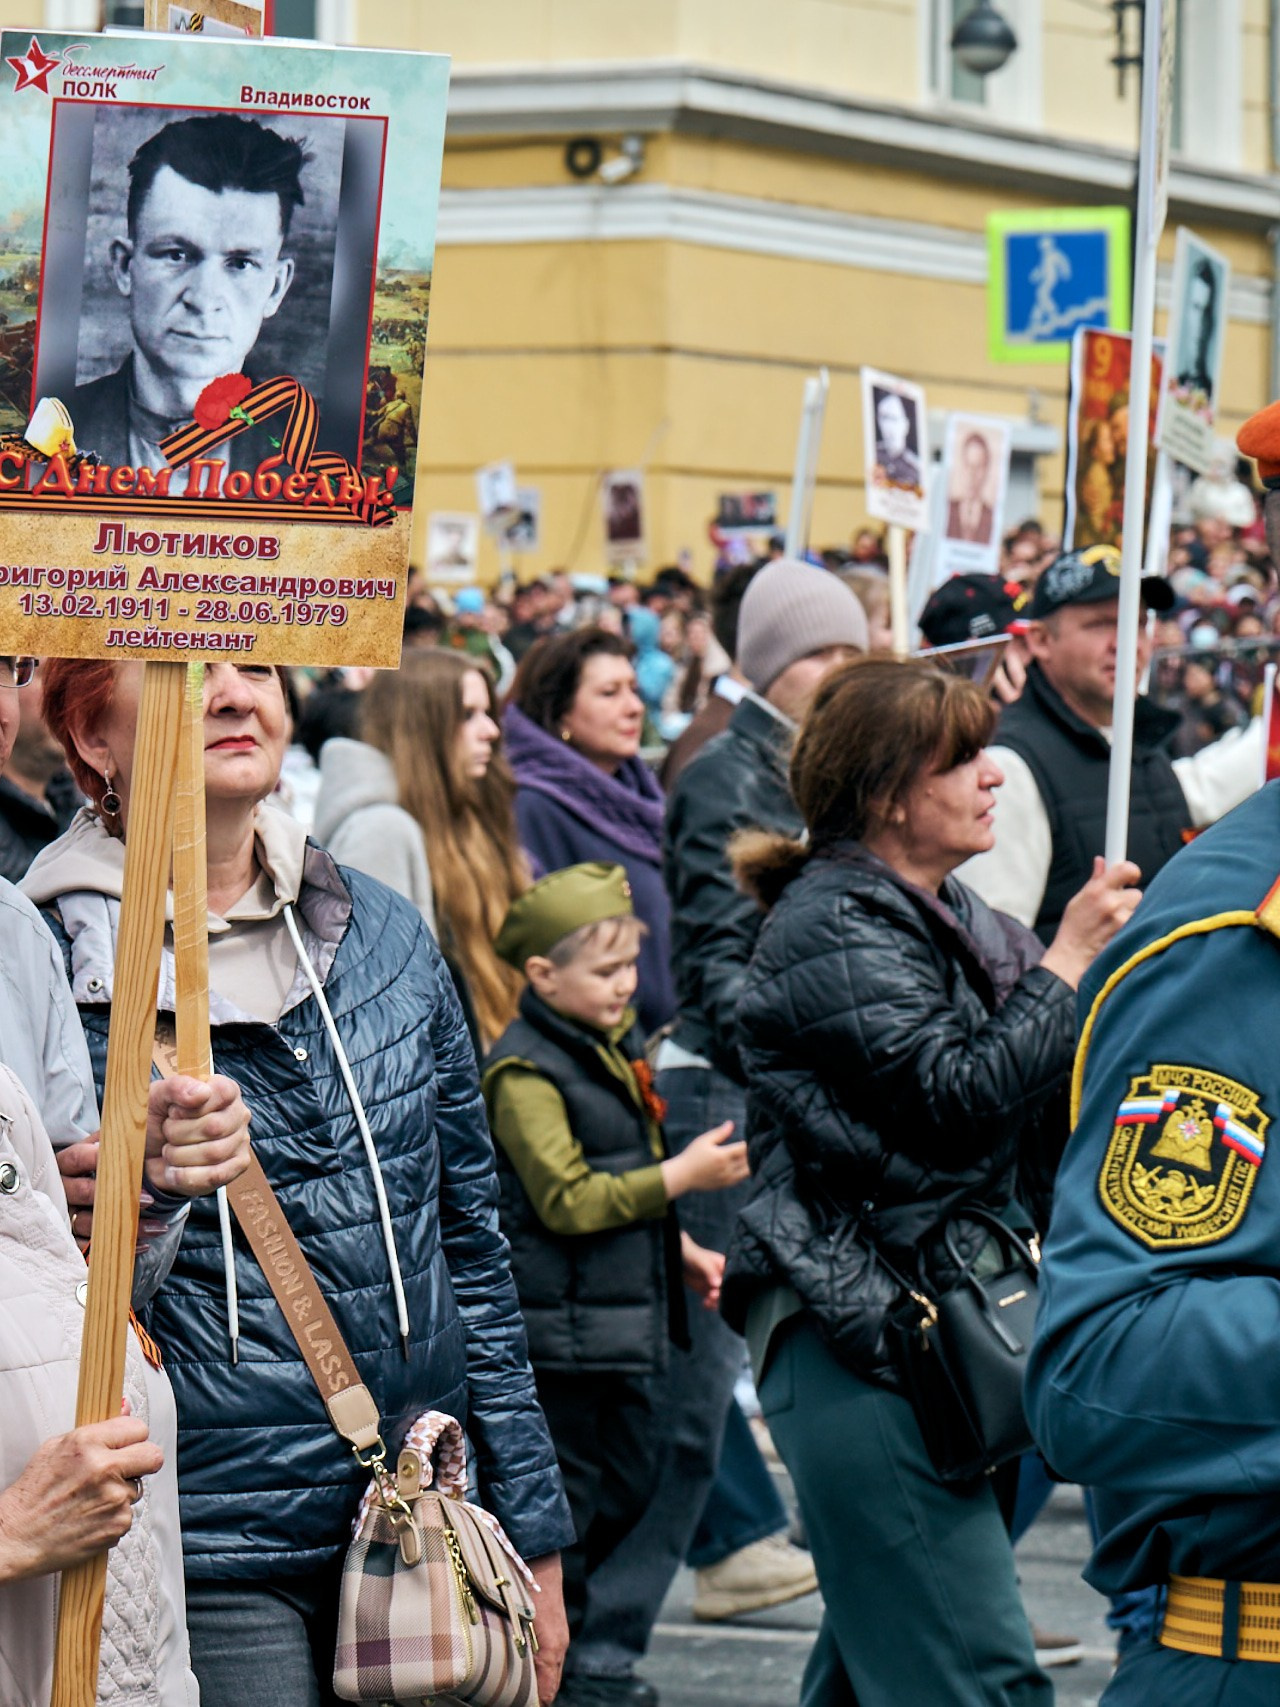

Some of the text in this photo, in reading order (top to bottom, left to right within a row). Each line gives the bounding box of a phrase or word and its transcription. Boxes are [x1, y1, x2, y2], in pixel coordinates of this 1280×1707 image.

[62, 80, 117, 98] ПОЛК
[240, 85, 371, 109] Владивосток
[1093, 336, 1113, 377] 9
[31, 453, 173, 499] Днем
[184, 453, 399, 508] Победы!
[93, 522, 281, 560] Лютиков
[137, 565, 397, 600] Александрович
[18, 593, 170, 620] 13.02.1911
[195, 599, 347, 625] 28.06.1979
[105, 626, 256, 652] лейтенант
[1157, 1070, 1251, 1109] МЧС РОССИИ
[240, 1188, 304, 1295] FASHION
[293, 1299, 313, 1323] &
